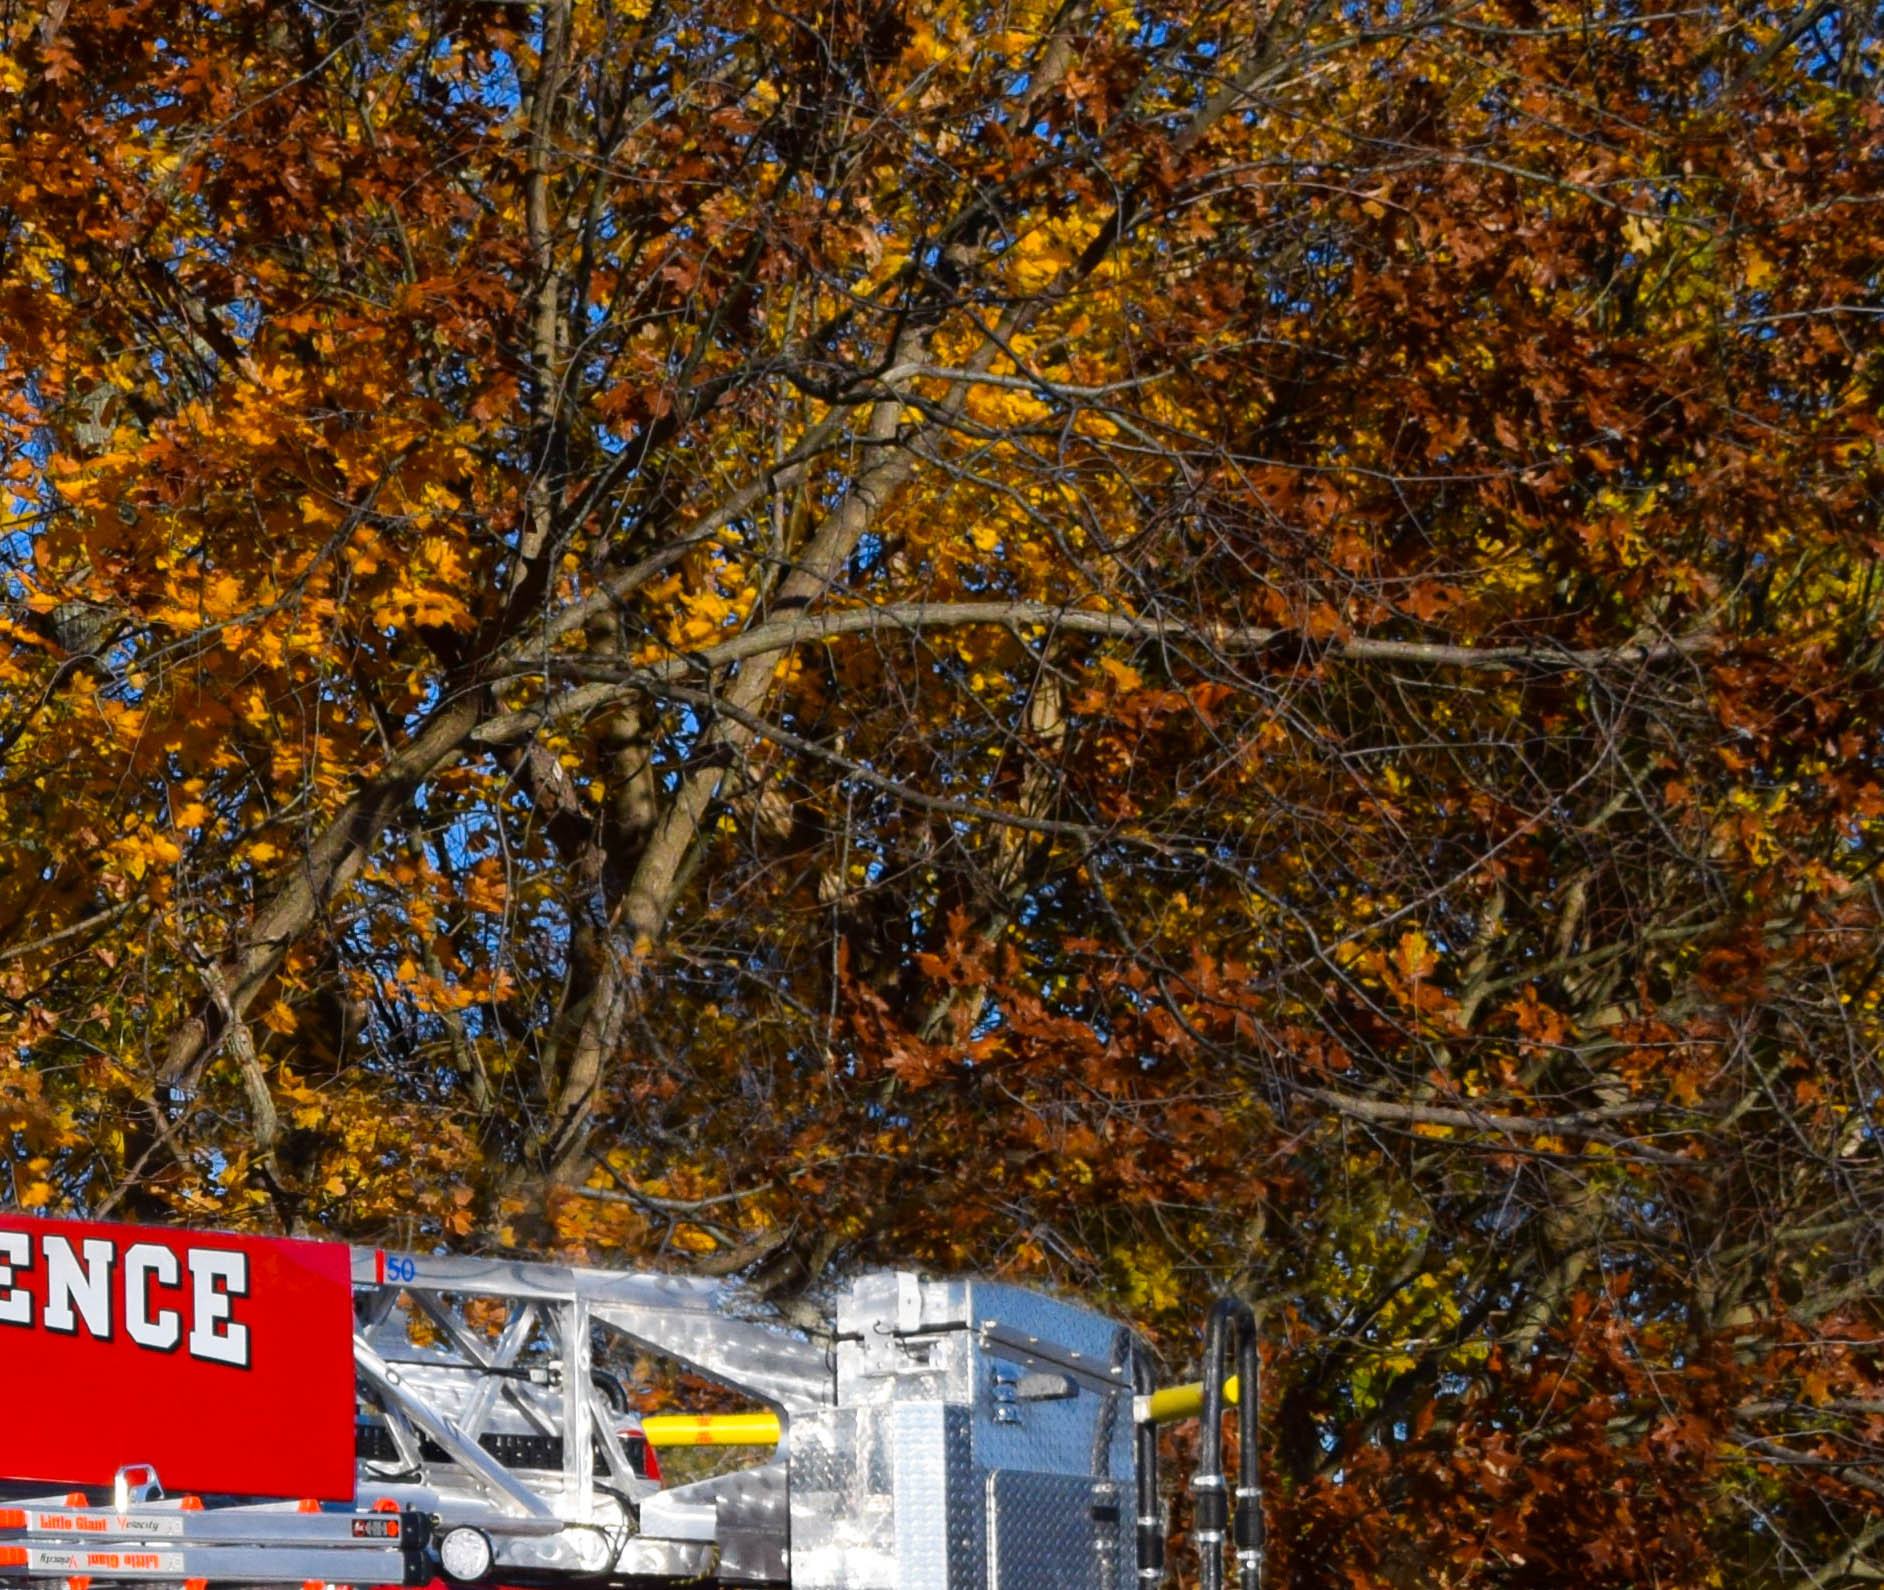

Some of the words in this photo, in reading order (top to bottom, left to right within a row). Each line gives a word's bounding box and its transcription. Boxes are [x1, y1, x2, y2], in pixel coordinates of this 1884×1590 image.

[386, 1256, 416, 1283] 50
[39, 1514, 73, 1530] Little
[75, 1516, 108, 1532] Giant
